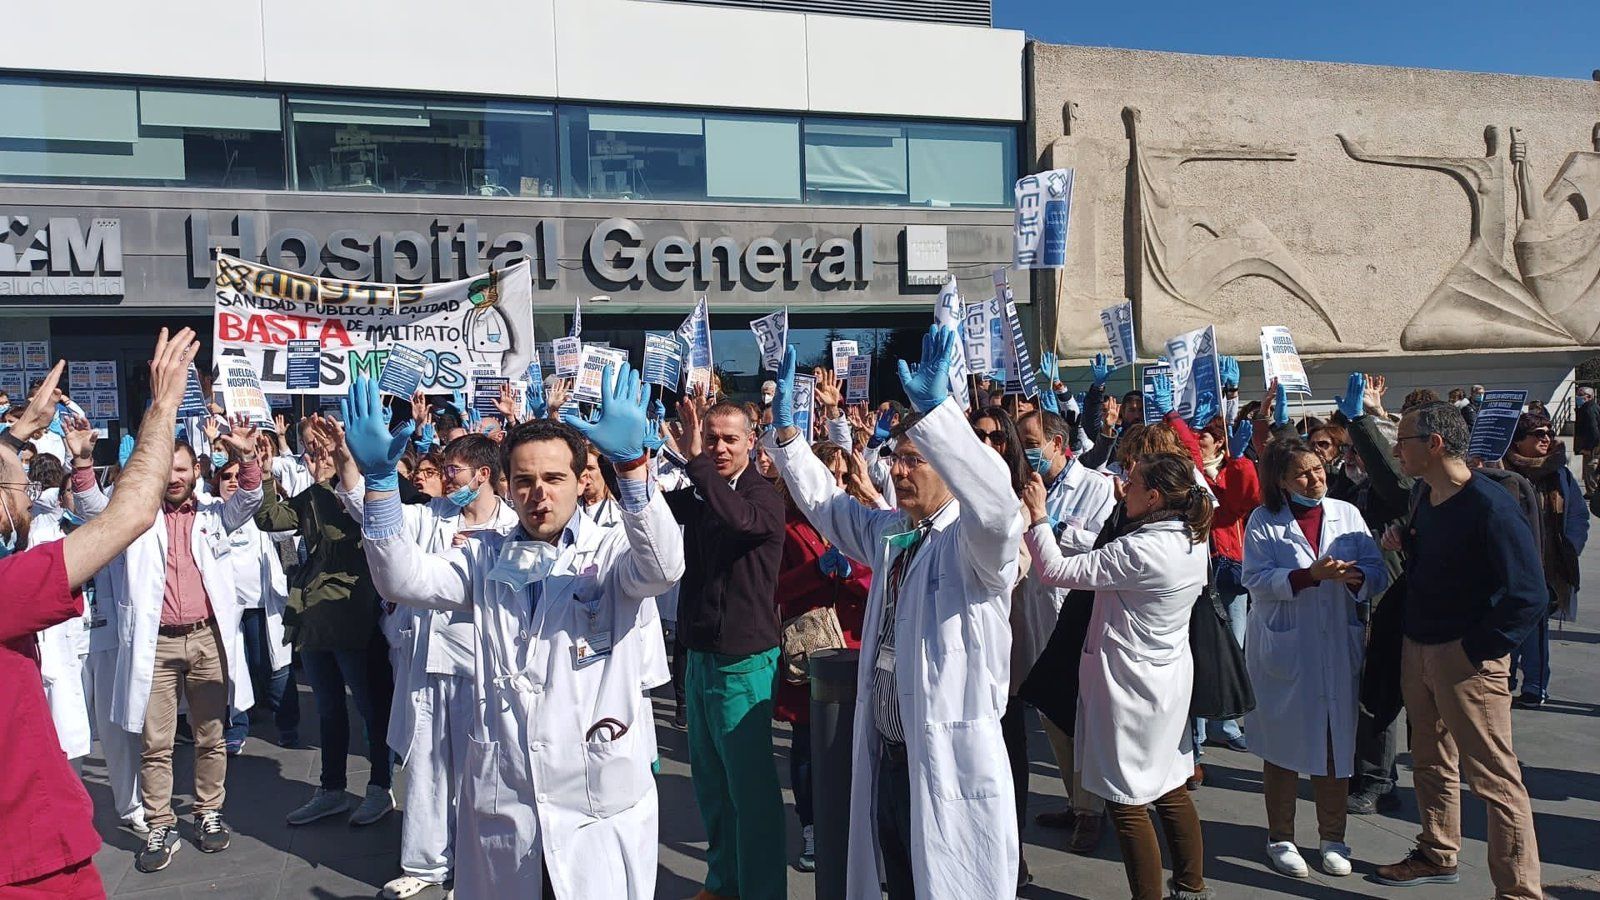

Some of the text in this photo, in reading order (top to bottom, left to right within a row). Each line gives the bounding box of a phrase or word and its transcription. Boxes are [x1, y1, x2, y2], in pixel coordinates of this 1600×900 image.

[186, 211, 874, 291] Hospital General
[0, 277, 121, 295] aludMadrid
[908, 274, 948, 285] Madrid
[216, 290, 297, 311] SANIDAD
[380, 306, 394, 316] DE
[400, 299, 460, 316] CALIDAD
[218, 312, 461, 349] BASTA DE MALTRATO
[347, 348, 467, 390] MEOS
